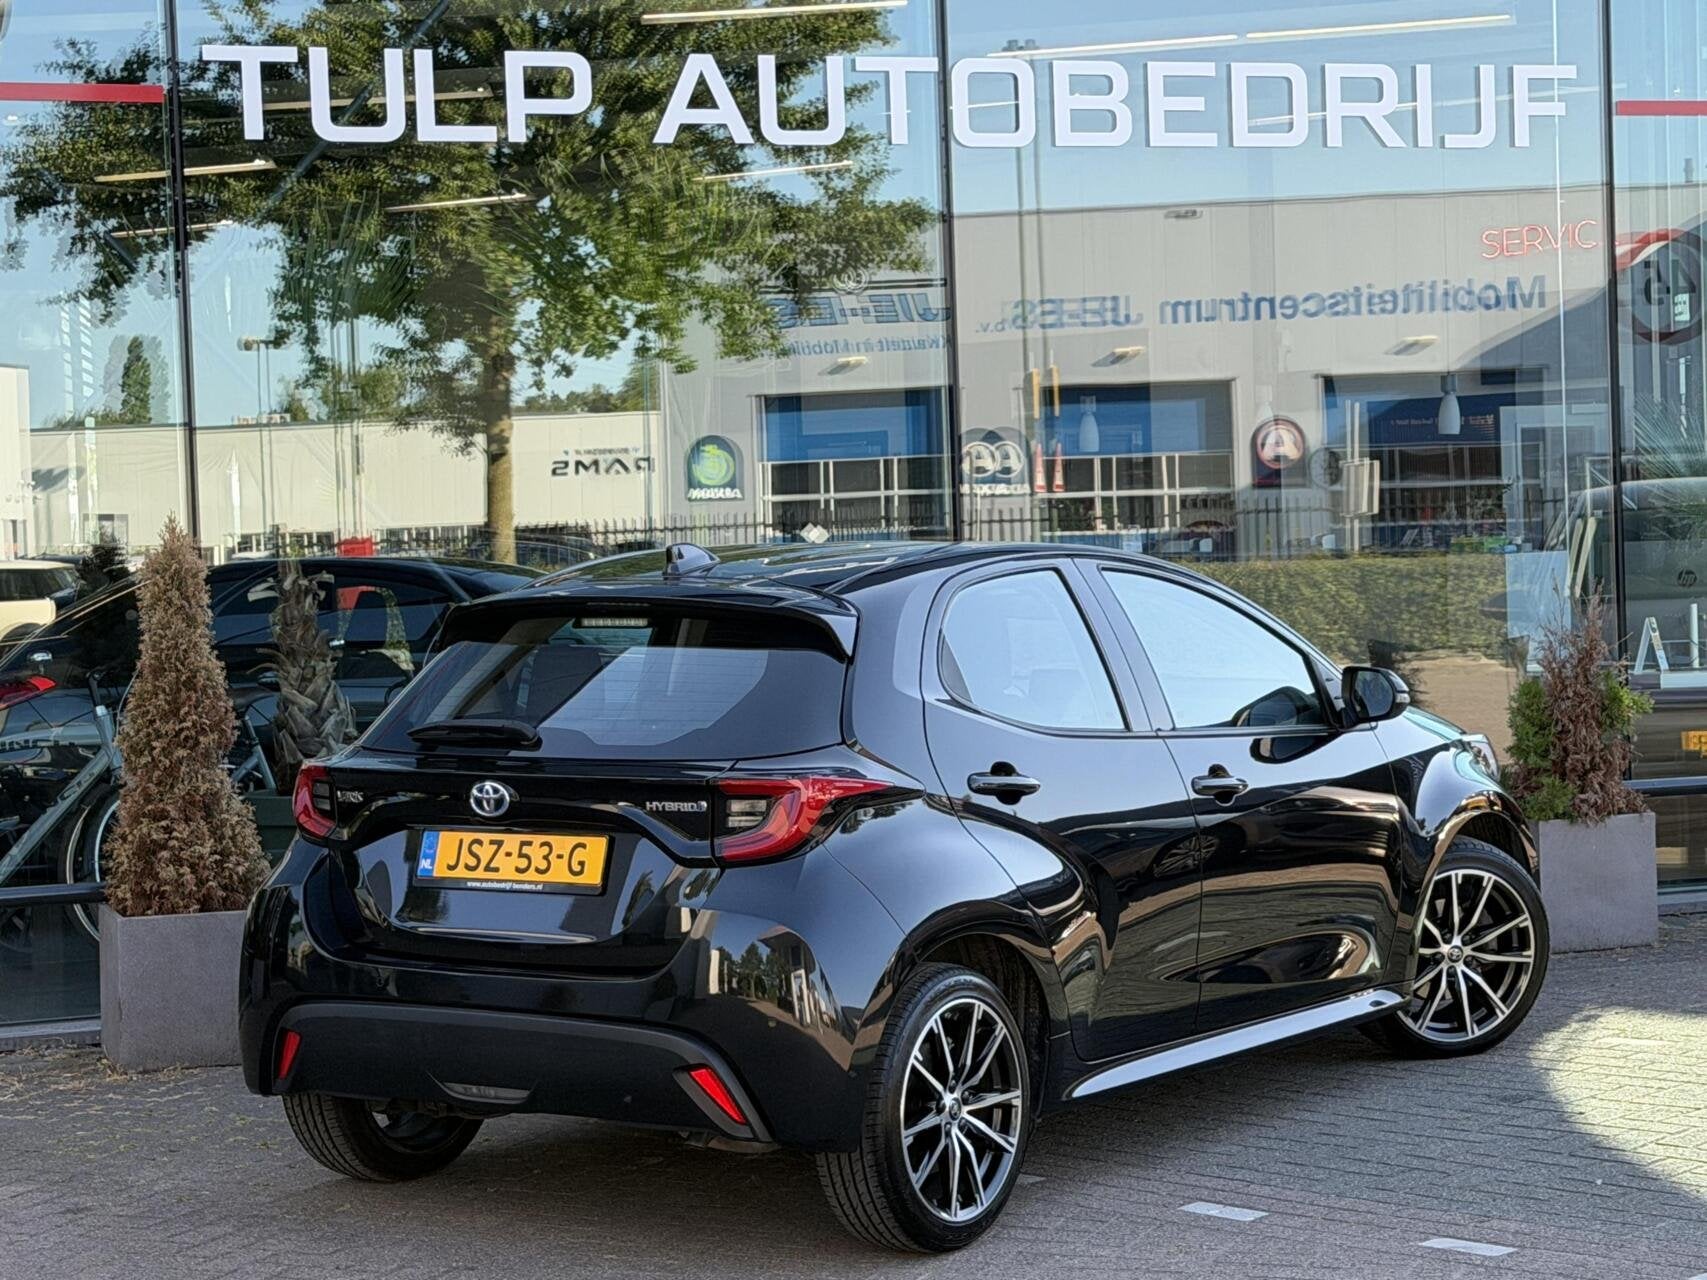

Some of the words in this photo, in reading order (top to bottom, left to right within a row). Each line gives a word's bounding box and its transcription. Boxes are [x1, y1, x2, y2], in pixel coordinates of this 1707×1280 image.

[201, 44, 593, 144] TULP
[652, 53, 1577, 149] AUTOBEDRIJF
[1480, 219, 1602, 260] SERVIC
[645, 801, 697, 812] HYBRID
[420, 858, 433, 870] NL
[446, 838, 588, 877] JSZ-53-G
